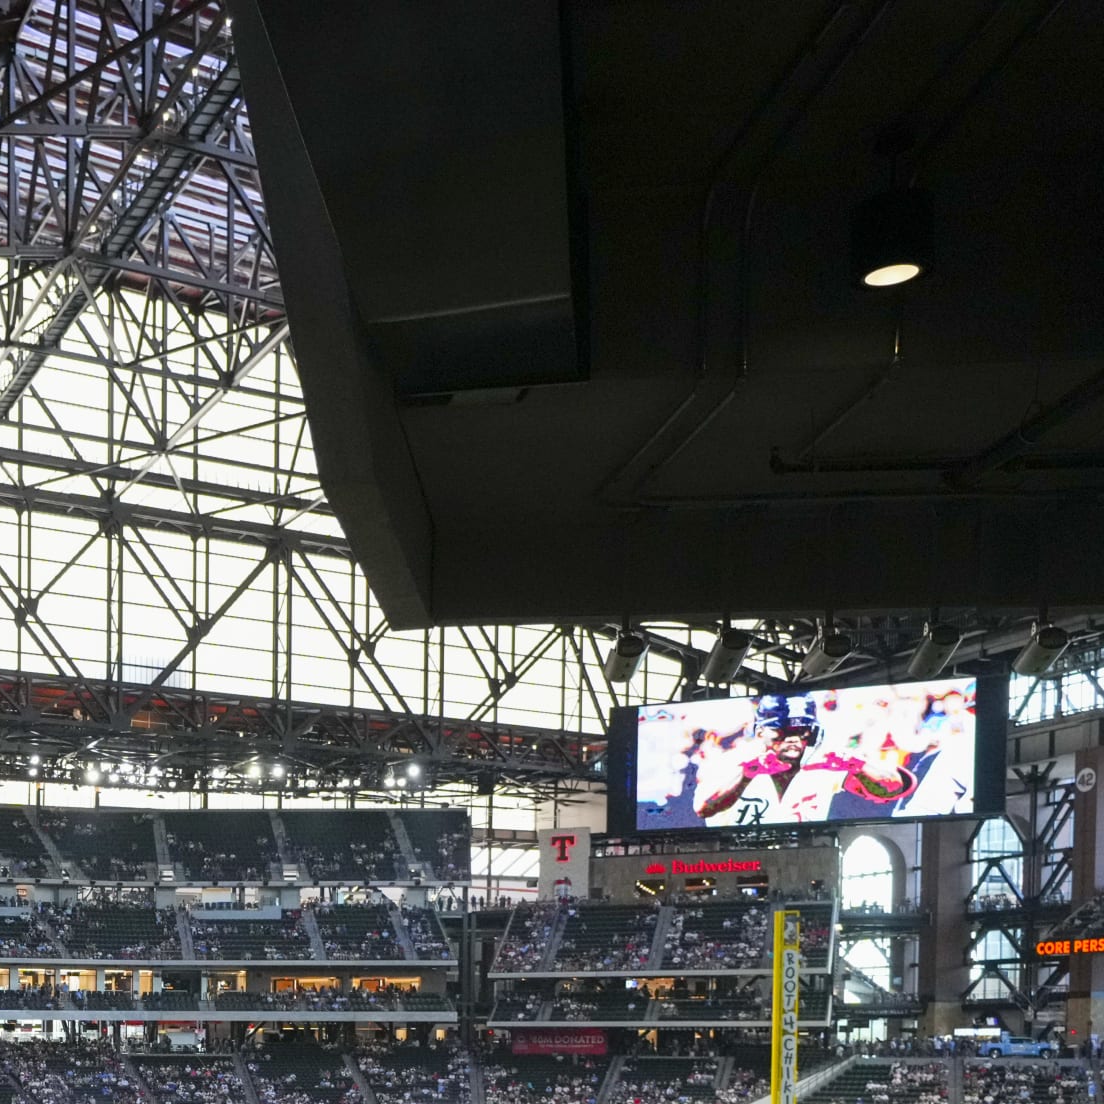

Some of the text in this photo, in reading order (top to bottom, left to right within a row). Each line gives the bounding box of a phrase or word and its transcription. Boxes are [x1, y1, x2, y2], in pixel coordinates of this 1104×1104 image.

[1077, 772, 1094, 787] 42
[550, 834, 576, 863] T
[672, 858, 761, 875] Budweiser
[1036, 938, 1104, 955] CORE PERS
[783, 1015, 796, 1030] 4
[554, 1035, 605, 1044] DONATED
